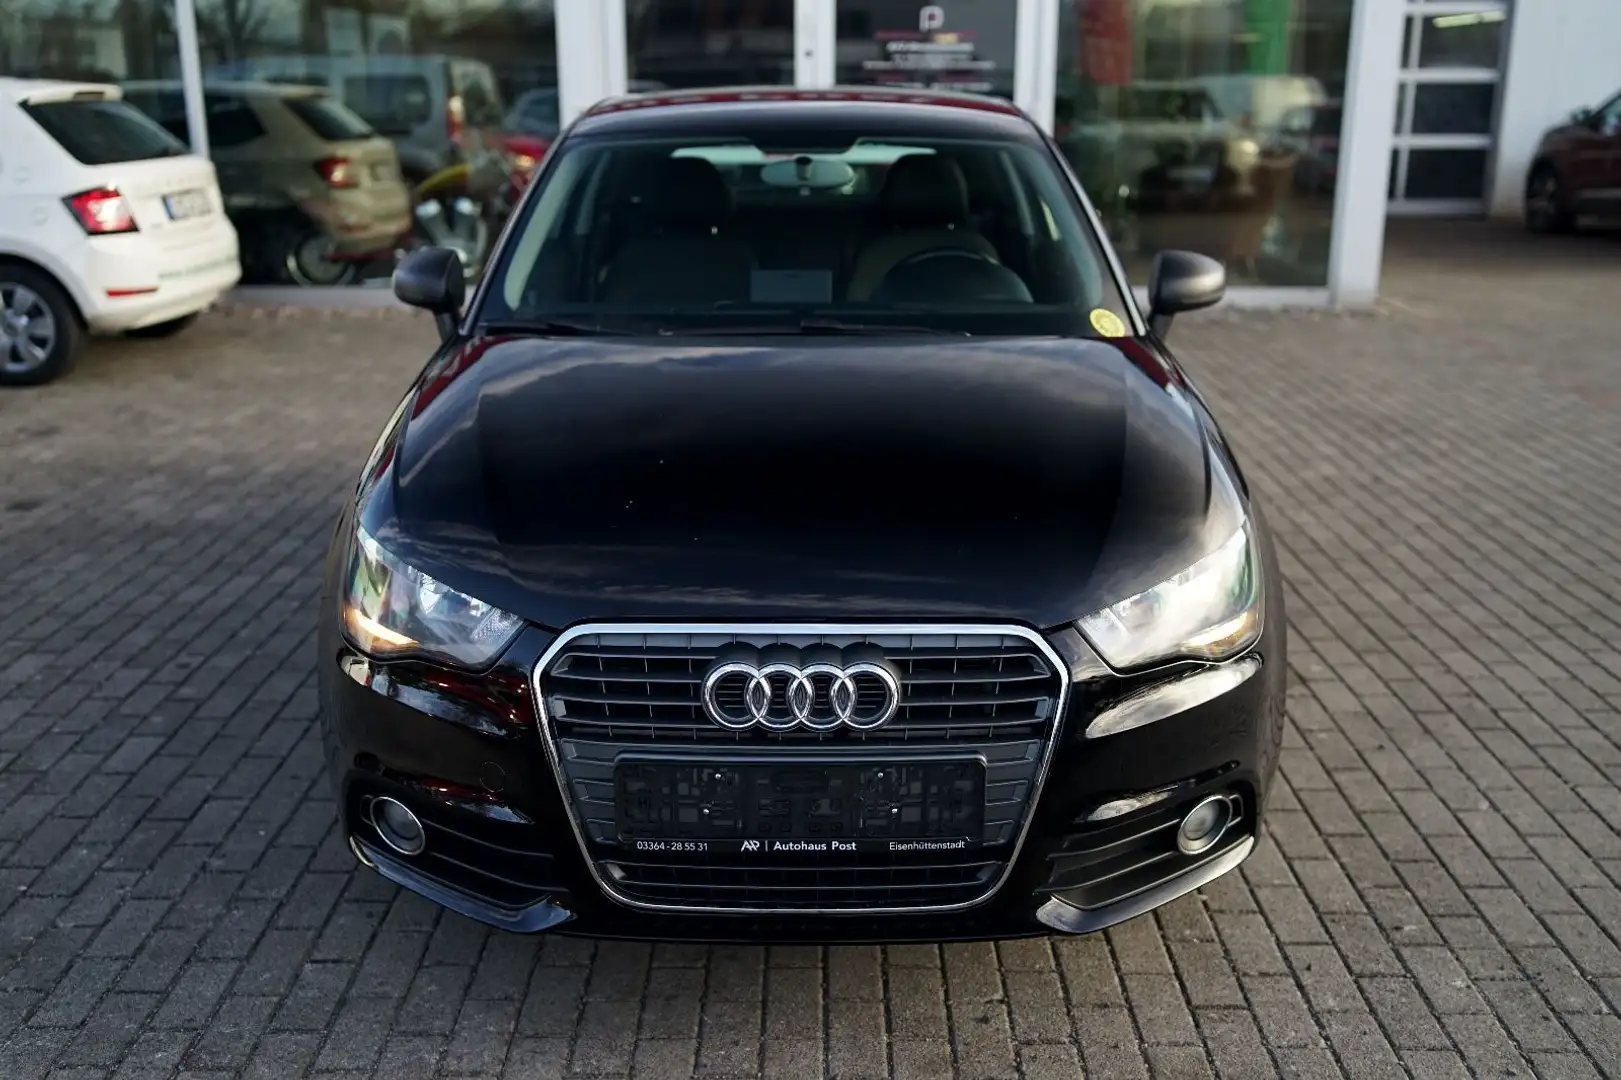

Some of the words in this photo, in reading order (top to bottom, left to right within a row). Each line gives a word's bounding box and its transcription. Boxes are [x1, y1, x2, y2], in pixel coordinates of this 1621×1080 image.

[684, 842, 696, 851] 55
[697, 842, 708, 851] 31
[773, 841, 827, 850] Autohaus
[832, 841, 857, 850] Post
[889, 840, 966, 850] Eisenhüttenstadt
